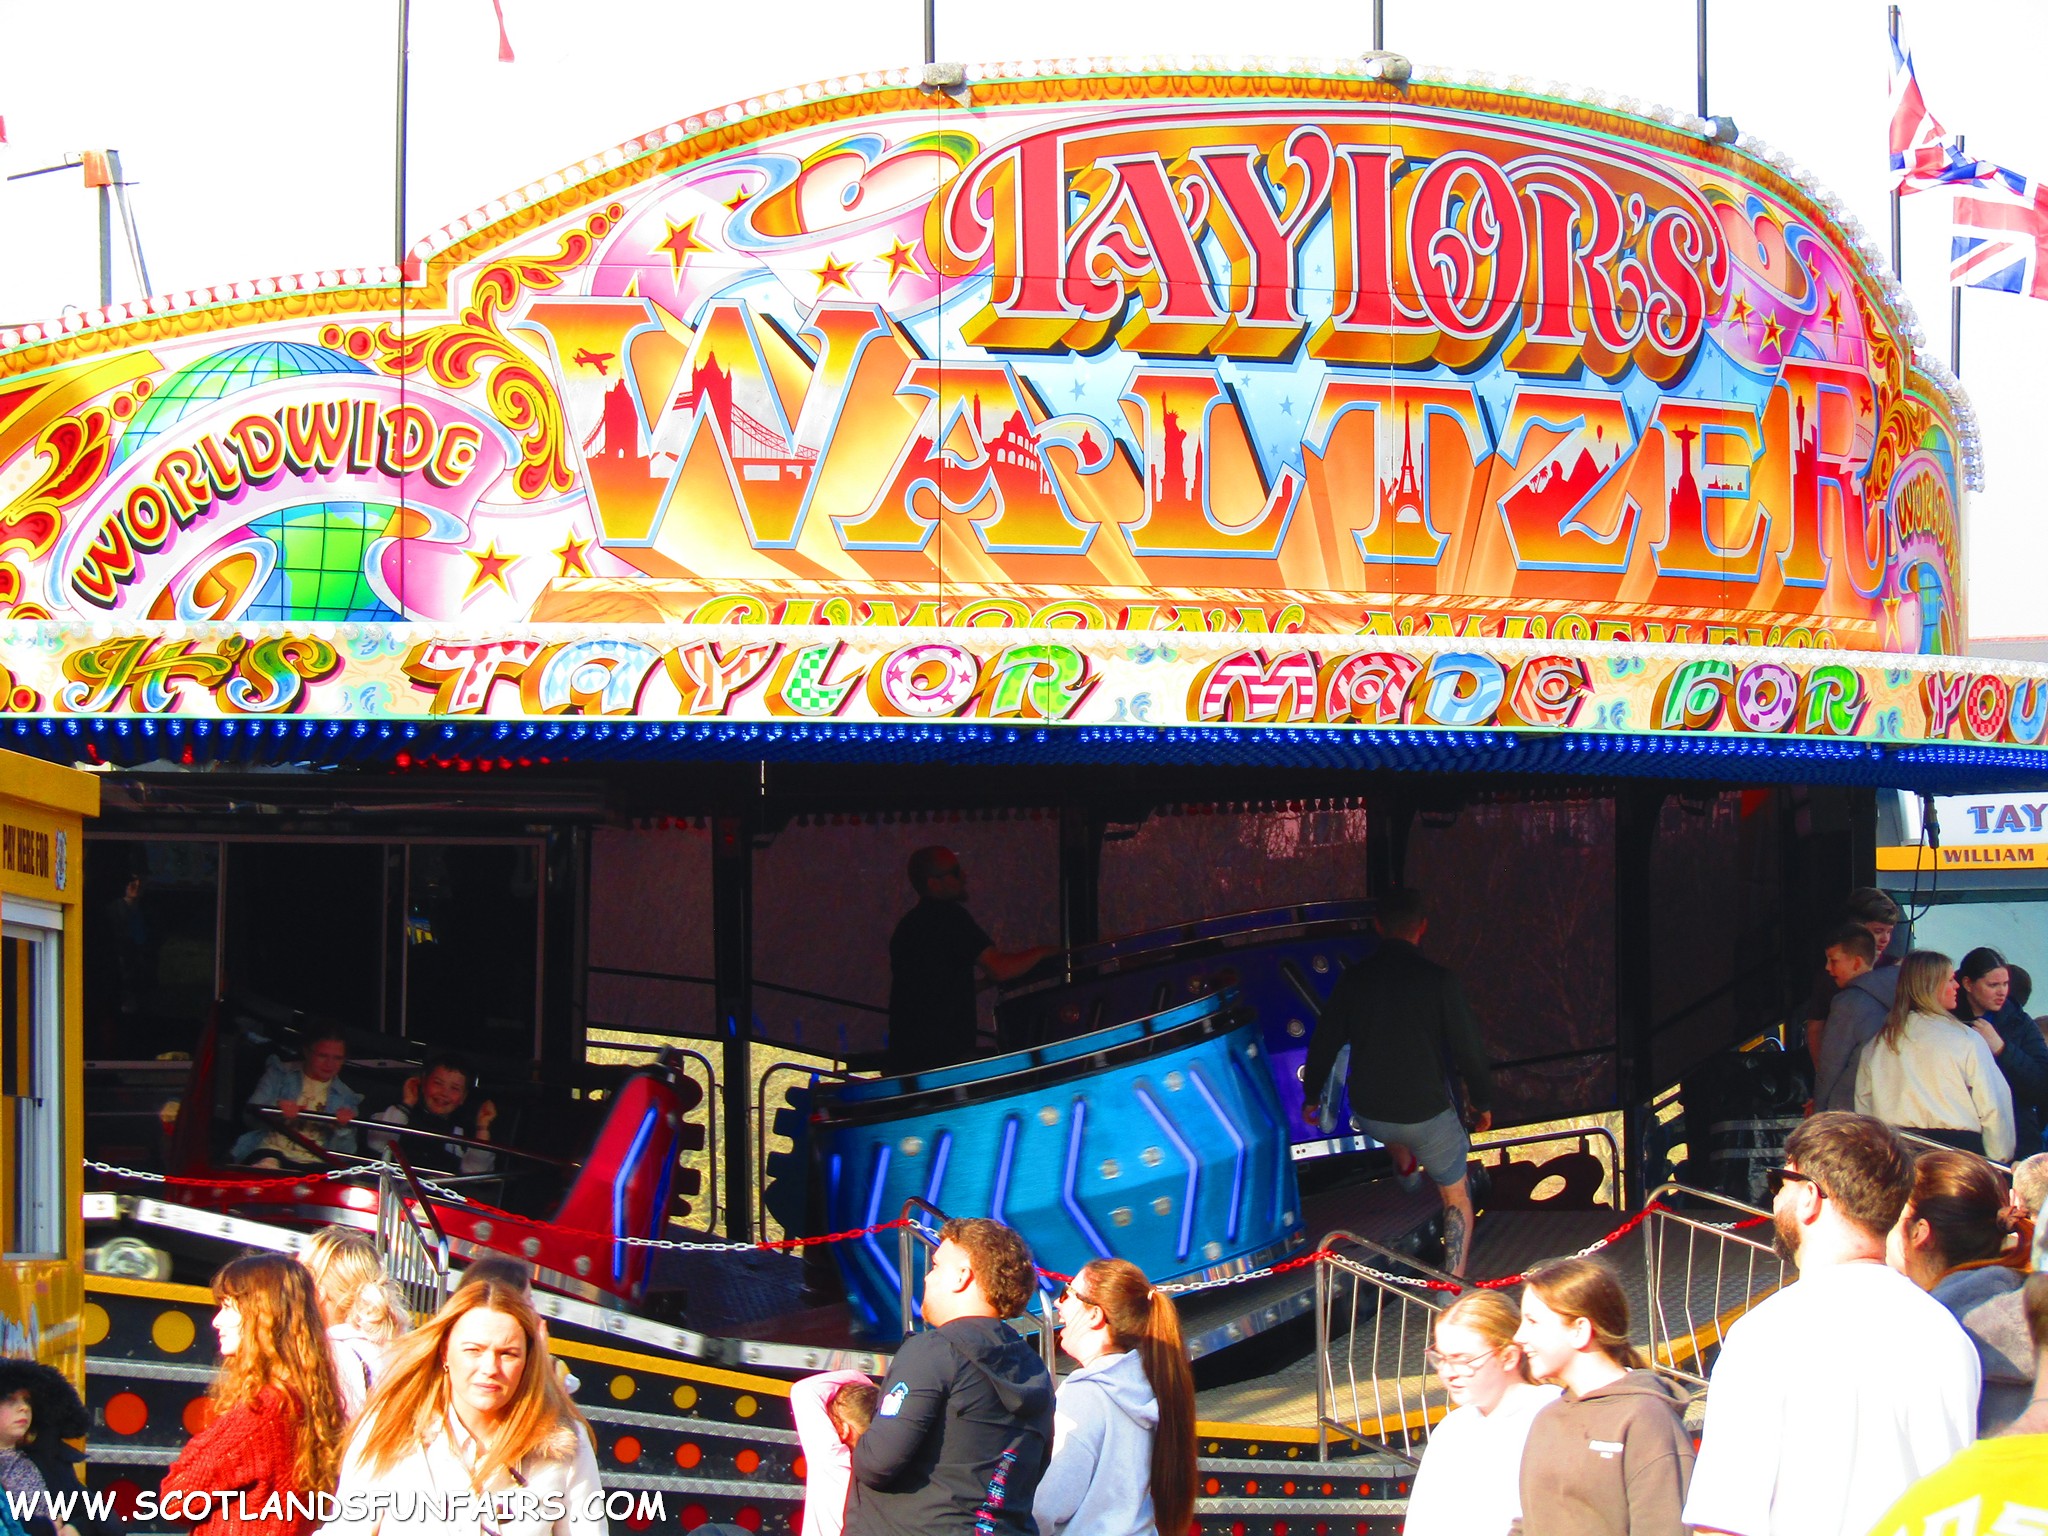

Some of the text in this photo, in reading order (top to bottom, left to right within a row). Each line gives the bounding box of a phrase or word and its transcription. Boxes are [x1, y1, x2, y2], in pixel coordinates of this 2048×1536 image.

[942, 108, 1730, 360] TAYLOR'S
[72, 397, 484, 604] WORLDWIDE
[507, 295, 1890, 598] WALTZER
[402, 636, 1104, 724] TAYLOR
[1186, 645, 1594, 731] MADE
[1648, 655, 1872, 739] FOR
[1918, 670, 2048, 745] YOU
[3, 823, 49, 879] PAY HERE FOR
[1944, 848, 2034, 863] WILLIAM
